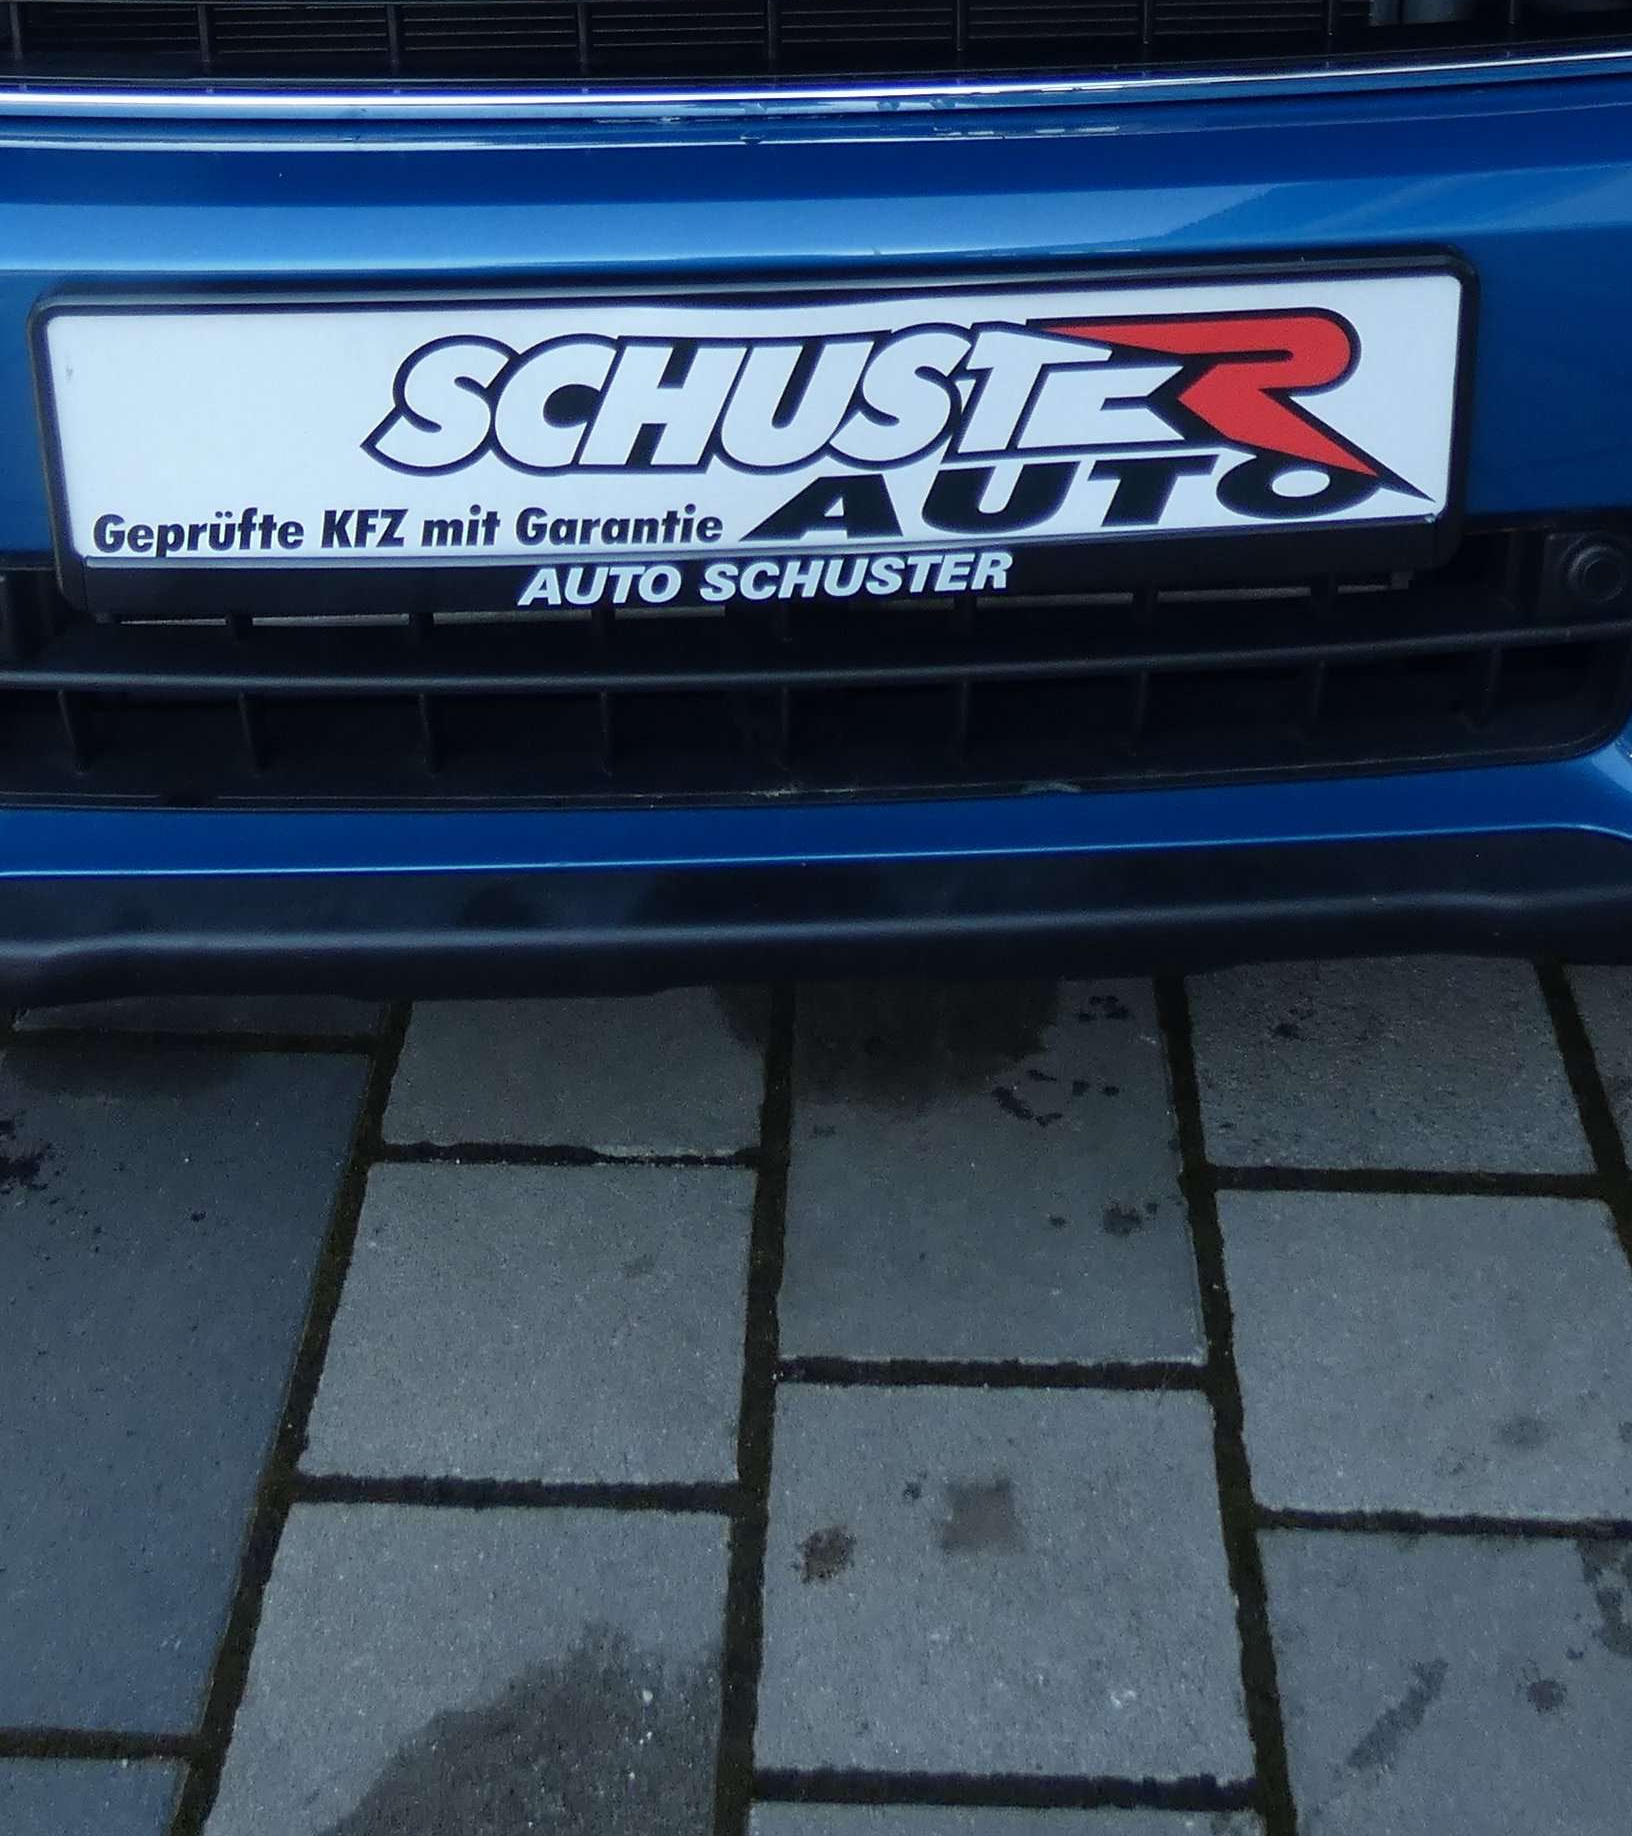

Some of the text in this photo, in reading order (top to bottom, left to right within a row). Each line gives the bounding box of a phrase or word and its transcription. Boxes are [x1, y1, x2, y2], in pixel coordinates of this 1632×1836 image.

[362, 306, 1418, 477] SCHUSTER
[92, 504, 724, 557] Geprüfte KFZ mit Garantie
[738, 447, 1380, 542] AUTO
[517, 551, 1013, 607] AUTO SCHUSTER
